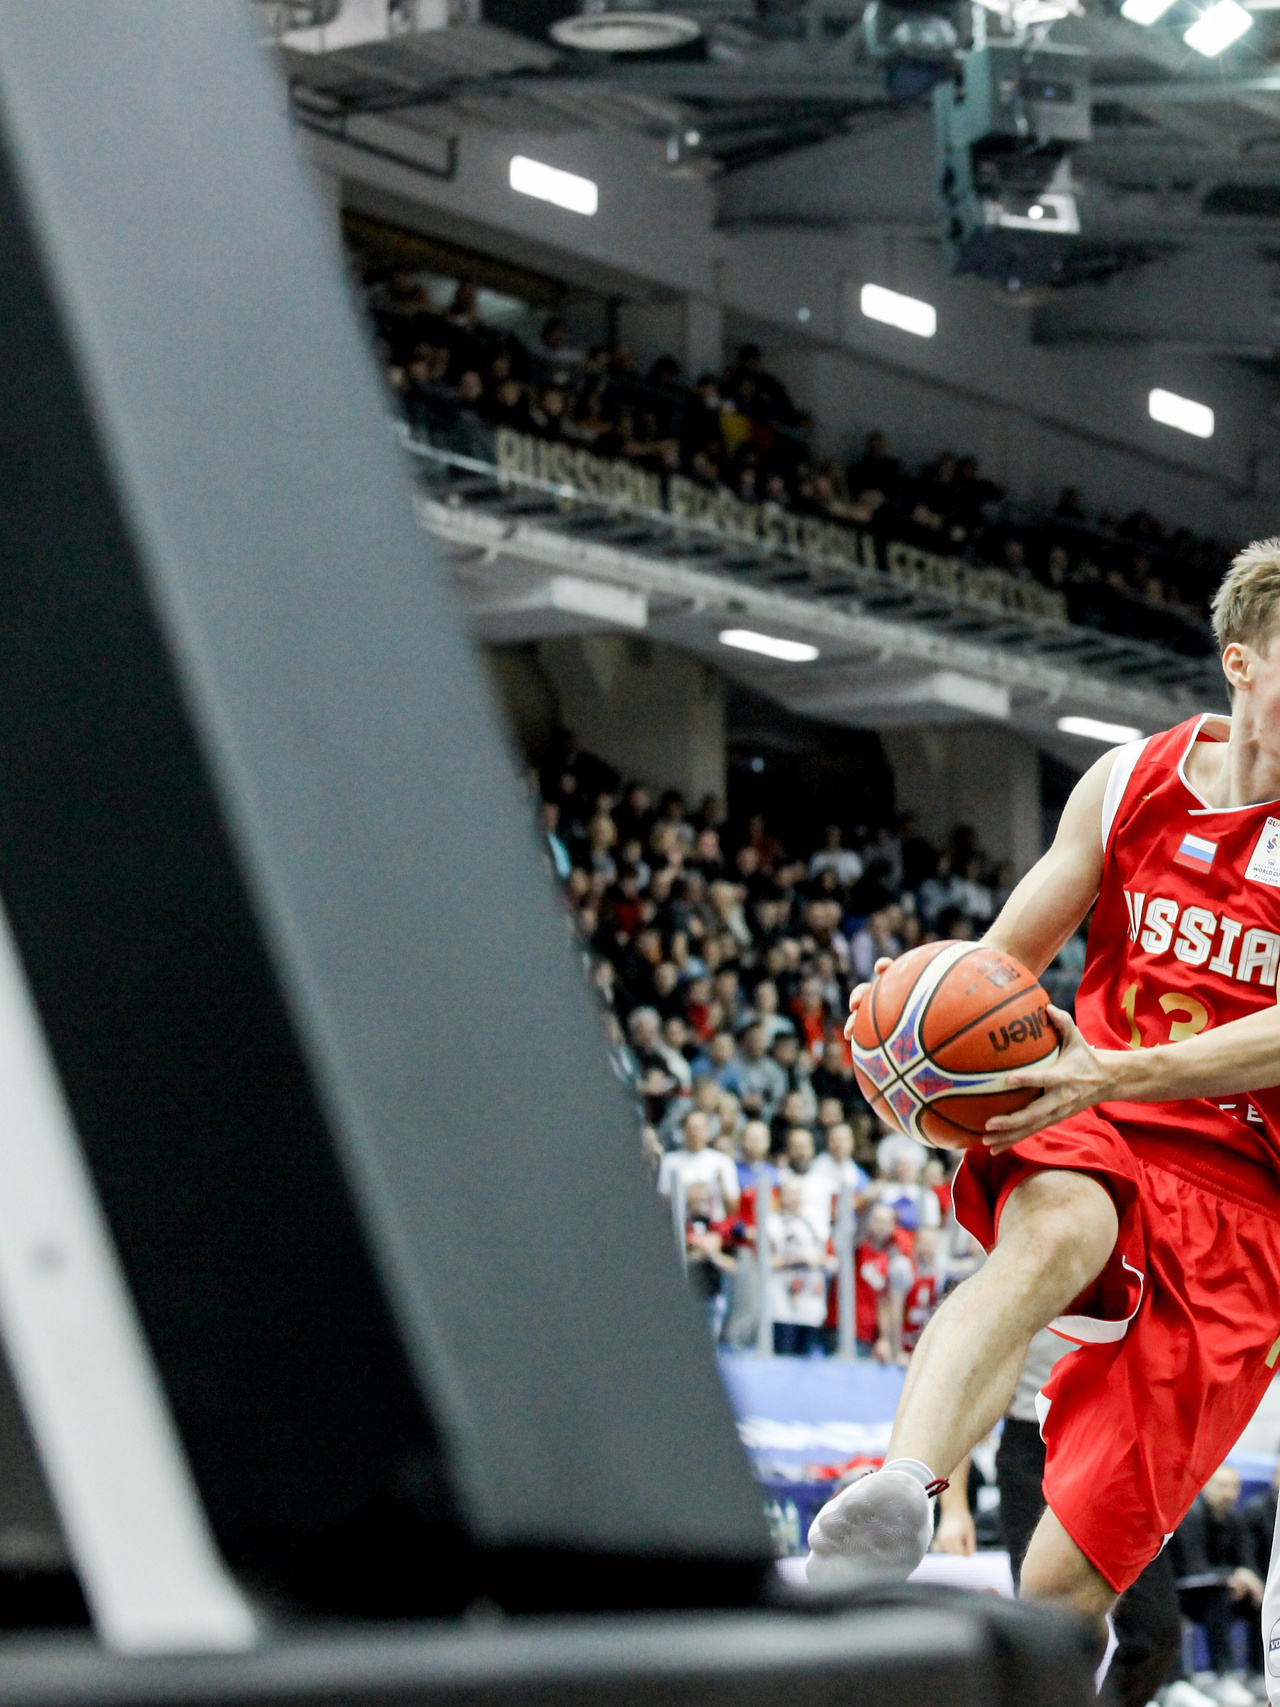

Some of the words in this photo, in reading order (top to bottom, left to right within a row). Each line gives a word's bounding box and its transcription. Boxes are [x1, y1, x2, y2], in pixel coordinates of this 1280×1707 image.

[1253, 866, 1273, 876] WORLD
[988, 1004, 1048, 1052] olten
[1120, 983, 1209, 1051] 13
